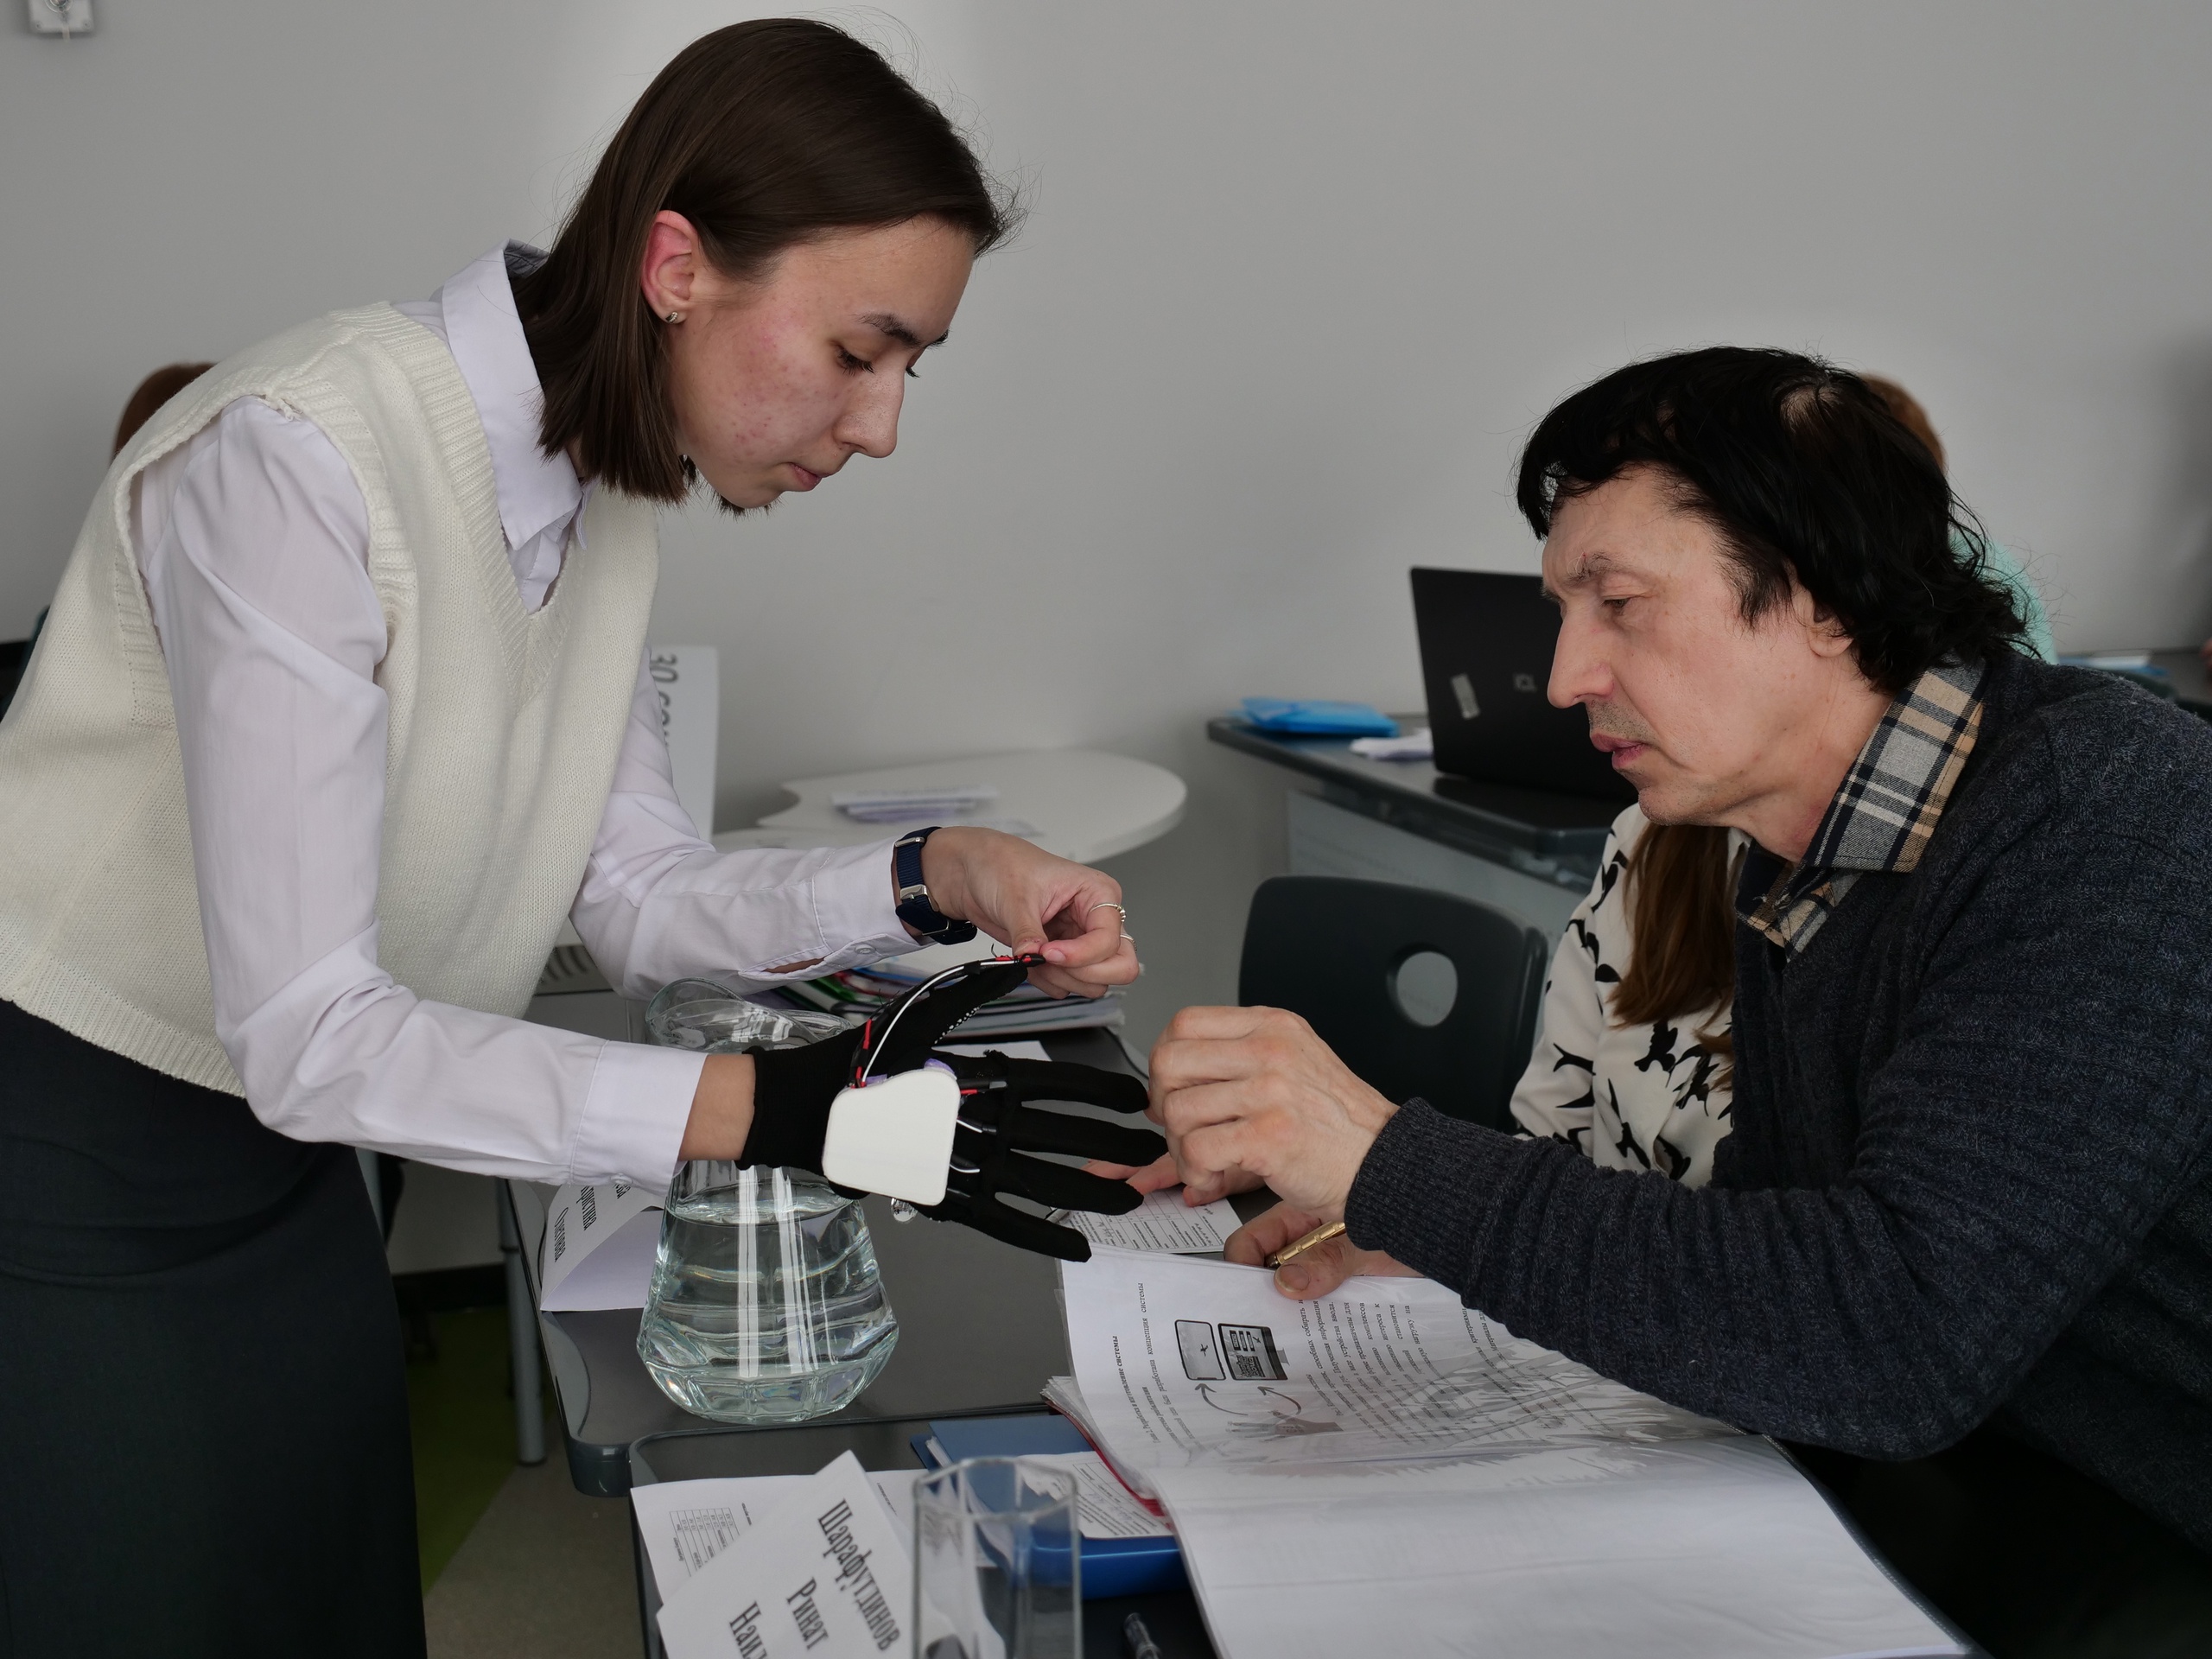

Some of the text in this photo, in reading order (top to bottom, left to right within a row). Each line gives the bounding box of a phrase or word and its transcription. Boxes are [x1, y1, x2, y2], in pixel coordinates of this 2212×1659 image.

[1138, 1283, 1147, 1313] системы
[1328, 1302, 1338, 1322] ввода.
[1142, 1318, 1154, 1355] концепция
[1299, 1307, 1312, 1337] собирать
[1313, 1300, 1327, 1340] информация
[1359, 1302, 1373, 1340] комплексов
[1376, 1313, 1389, 1340] интереса
[1389, 1304, 1403, 1340] становится
[1404, 1305, 1421, 1344] нагрузку на
[1461, 1308, 1478, 1344] критериями
[1113, 1336, 1122, 1366] системы
[1333, 1325, 1351, 1358] устройства
[1346, 1317, 1367, 1360] предназначены
[1481, 1323, 1498, 1352] Материалы
[1307, 1339, 1323, 1370] способных
[1324, 1343, 1342, 1374] Полученная
[1118, 1368, 1135, 1403] изготовление
[1149, 1359, 1166, 1392] разработана
[1141, 1386, 1164, 1416] реабилитации
[1134, 1408, 1151, 1429] Разработка
[817, 1497, 900, 1651] Шарафутдинов
[786, 1576, 829, 1650] Ринат
